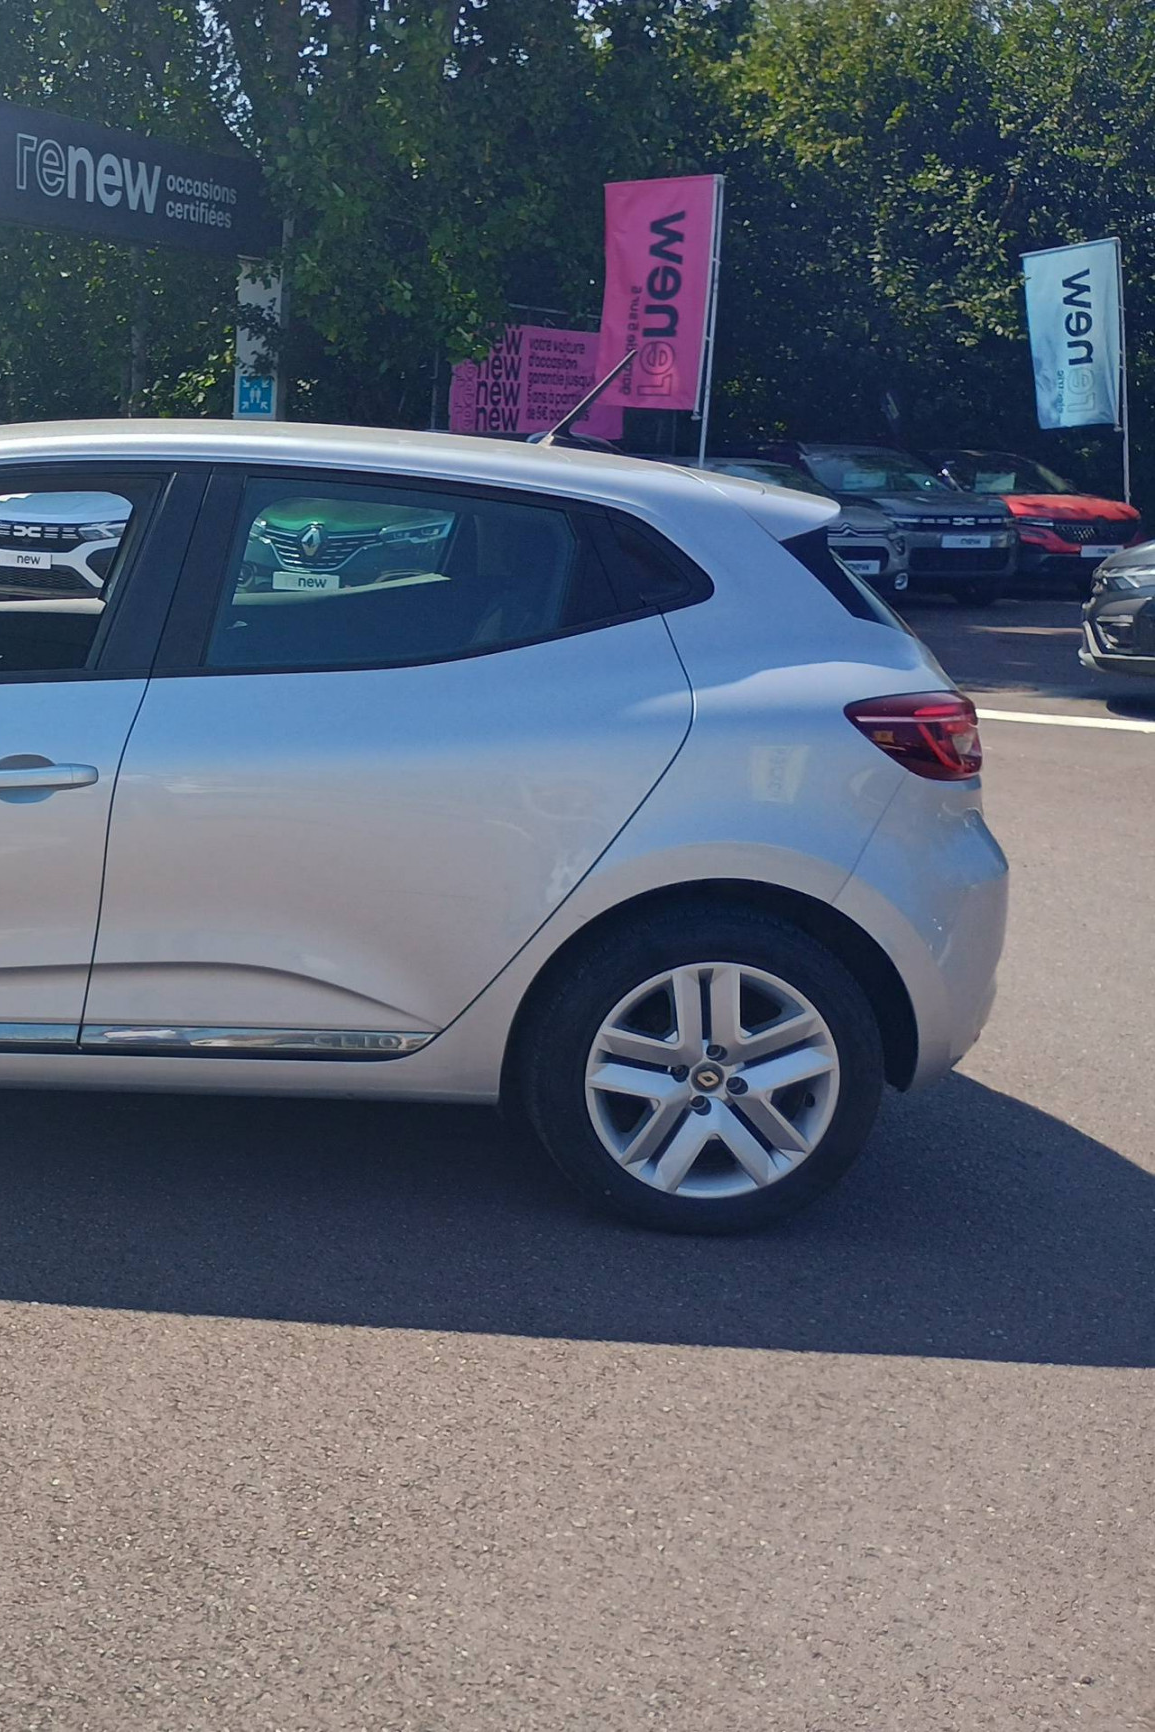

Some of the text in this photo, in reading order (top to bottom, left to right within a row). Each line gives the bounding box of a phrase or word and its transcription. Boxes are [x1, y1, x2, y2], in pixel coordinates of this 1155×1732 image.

[16, 133, 162, 214] renew
[166, 173, 238, 206] occasions
[166, 197, 233, 229] certifiées
[16, 554, 41, 565] new
[314, 1034, 399, 1049] CLIO
